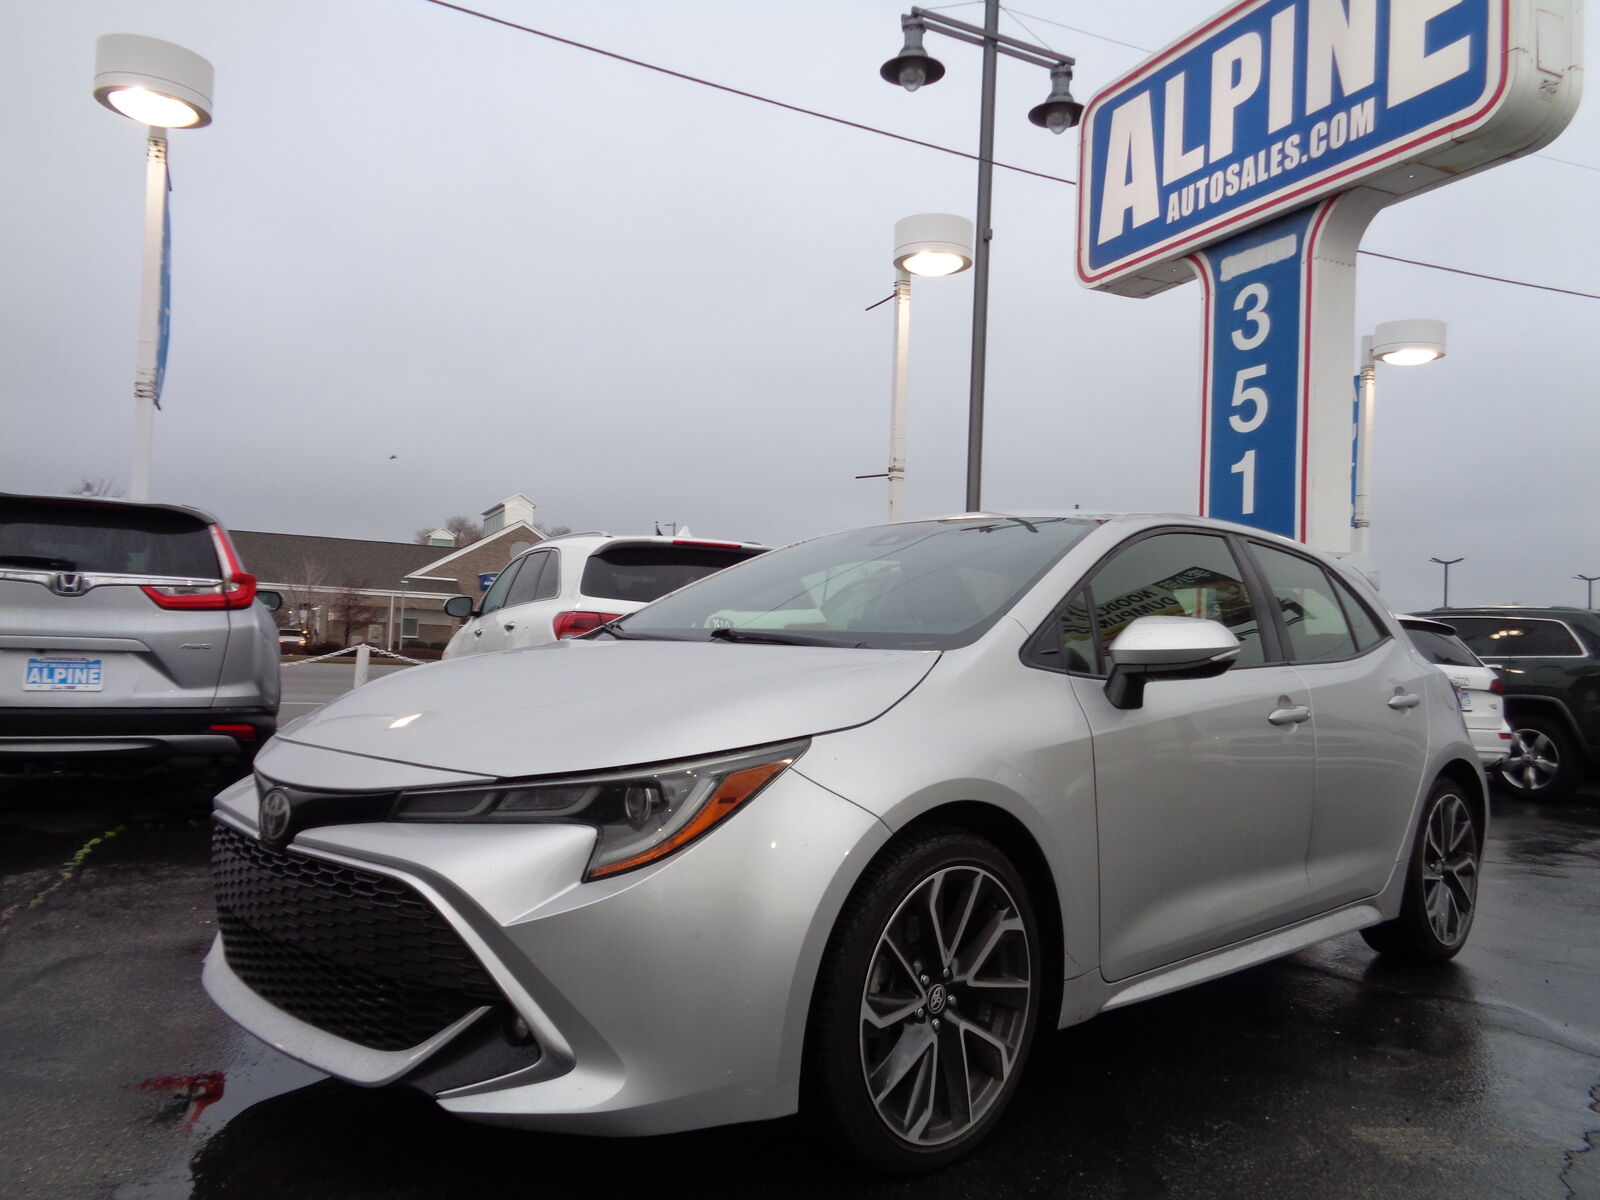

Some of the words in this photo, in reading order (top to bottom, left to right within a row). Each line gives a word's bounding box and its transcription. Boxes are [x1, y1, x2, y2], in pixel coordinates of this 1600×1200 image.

[1097, 0, 1470, 245] ALPINE
[1166, 97, 1375, 224] AUTOSALES.COM
[27, 668, 100, 684] ALPINE
